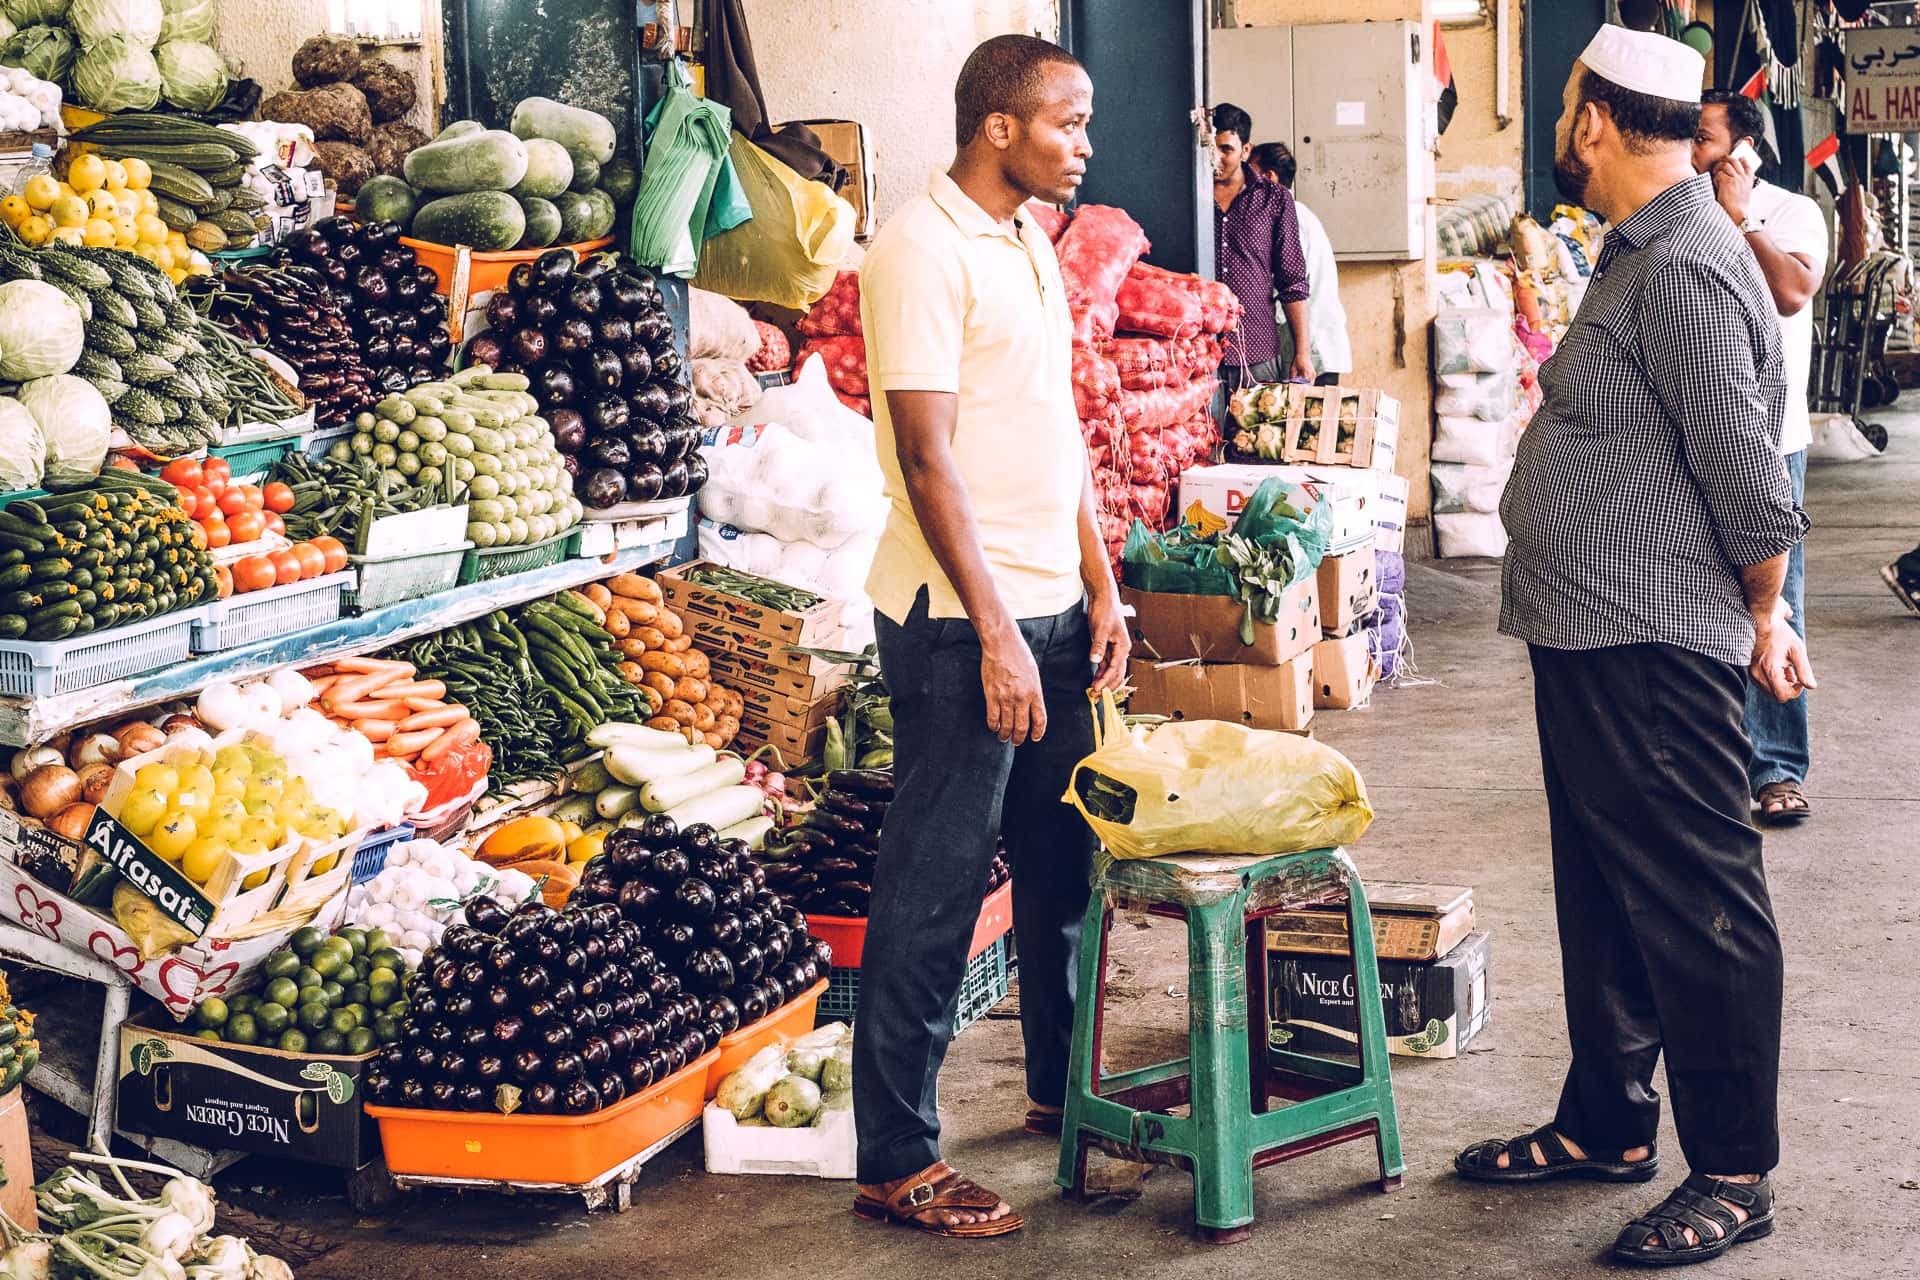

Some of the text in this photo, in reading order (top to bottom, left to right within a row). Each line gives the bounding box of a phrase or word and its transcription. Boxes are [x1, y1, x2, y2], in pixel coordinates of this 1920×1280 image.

[1852, 86, 1877, 120] AL
[88, 821, 193, 921] Alfasat
[1302, 972, 1340, 996] NICE
[1319, 997, 1354, 1006] Export and
[229, 1101, 244, 1109] and
[245, 1103, 270, 1114] Export
[186, 1103, 290, 1144] NICE GREEN
